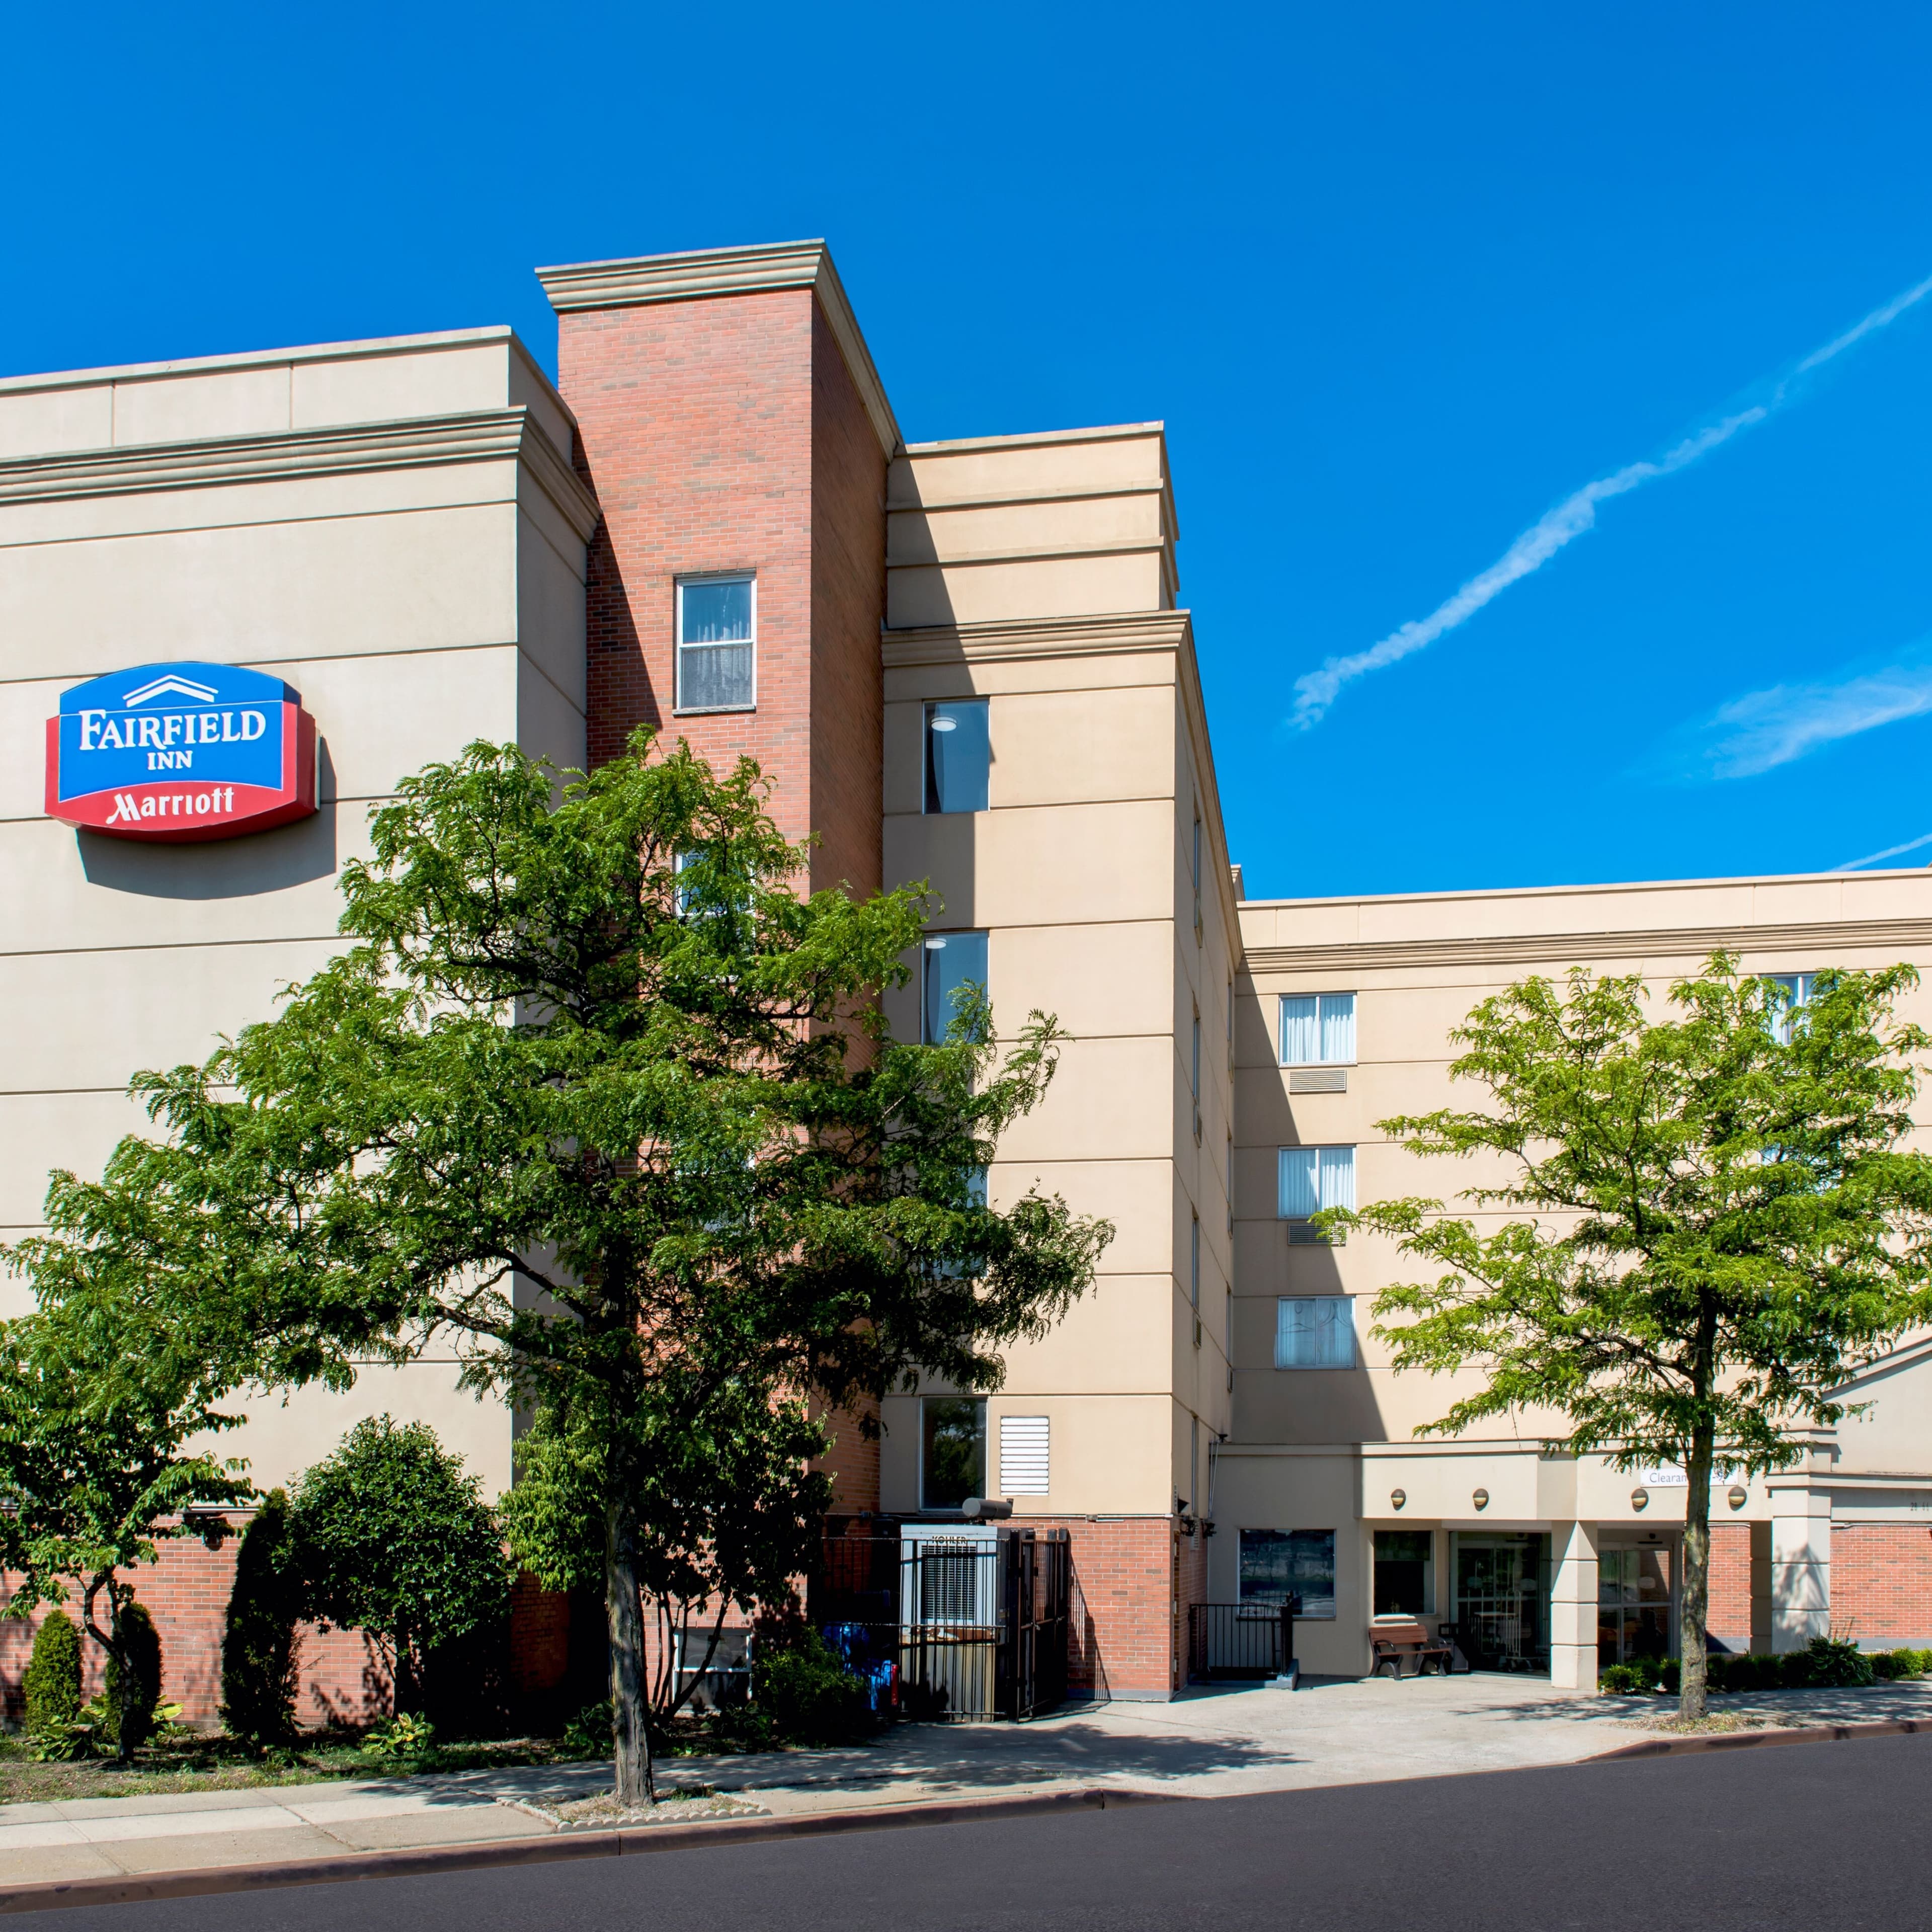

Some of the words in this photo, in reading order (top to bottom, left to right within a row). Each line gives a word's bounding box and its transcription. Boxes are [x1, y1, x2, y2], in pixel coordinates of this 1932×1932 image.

[78, 709, 267, 750] FAIRFIELD
[147, 750, 193, 770] INN
[106, 786, 234, 824] Marriott
[1649, 1472, 1687, 1483] Clearan
[932, 1536, 967, 1544] KOHLER
